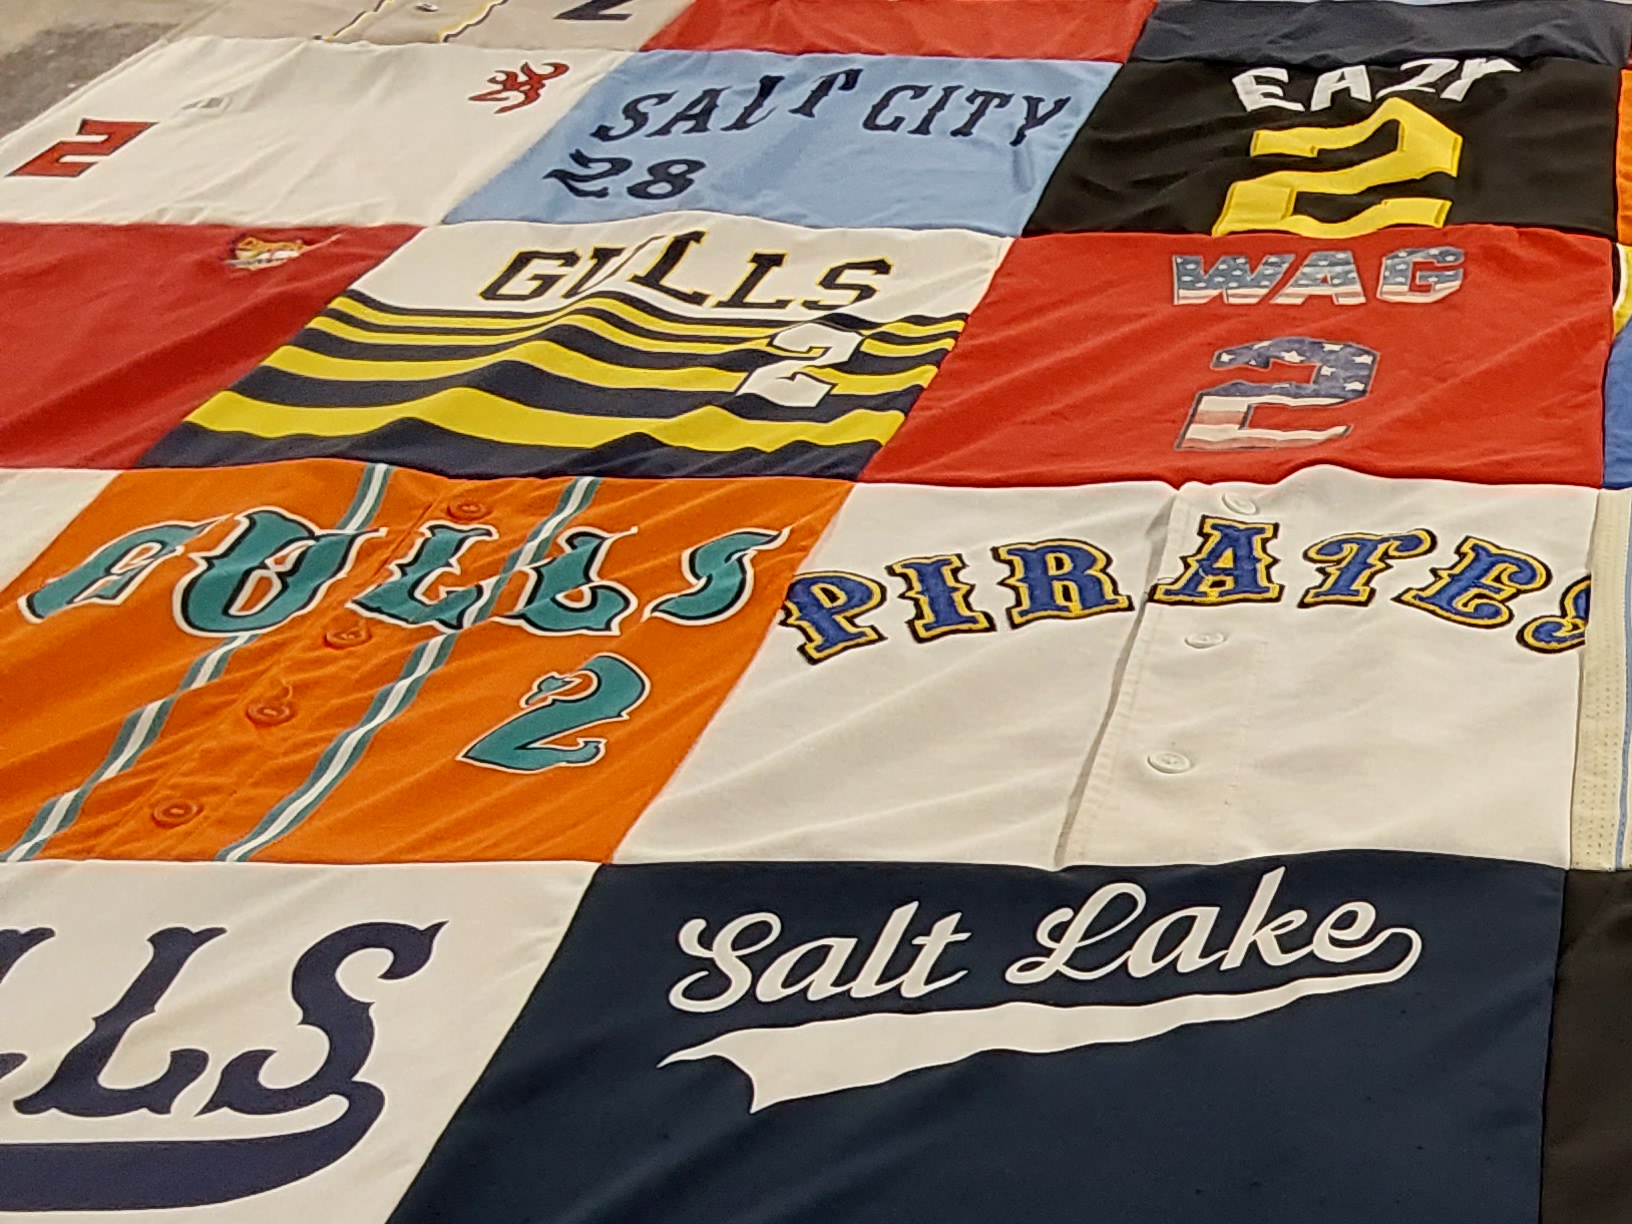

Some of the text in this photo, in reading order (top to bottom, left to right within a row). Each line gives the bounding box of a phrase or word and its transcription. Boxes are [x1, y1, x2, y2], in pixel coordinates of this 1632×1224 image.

[4, 118, 160, 178] 2
[861, 83, 1073, 147] CITY
[542, 148, 706, 200] 28
[1211, 97, 1463, 238] 2
[735, 321, 868, 408] 2
[1174, 336, 1380, 451] 2
[456, 653, 652, 775] 2
[668, 865, 1422, 1013] Salt Lake
